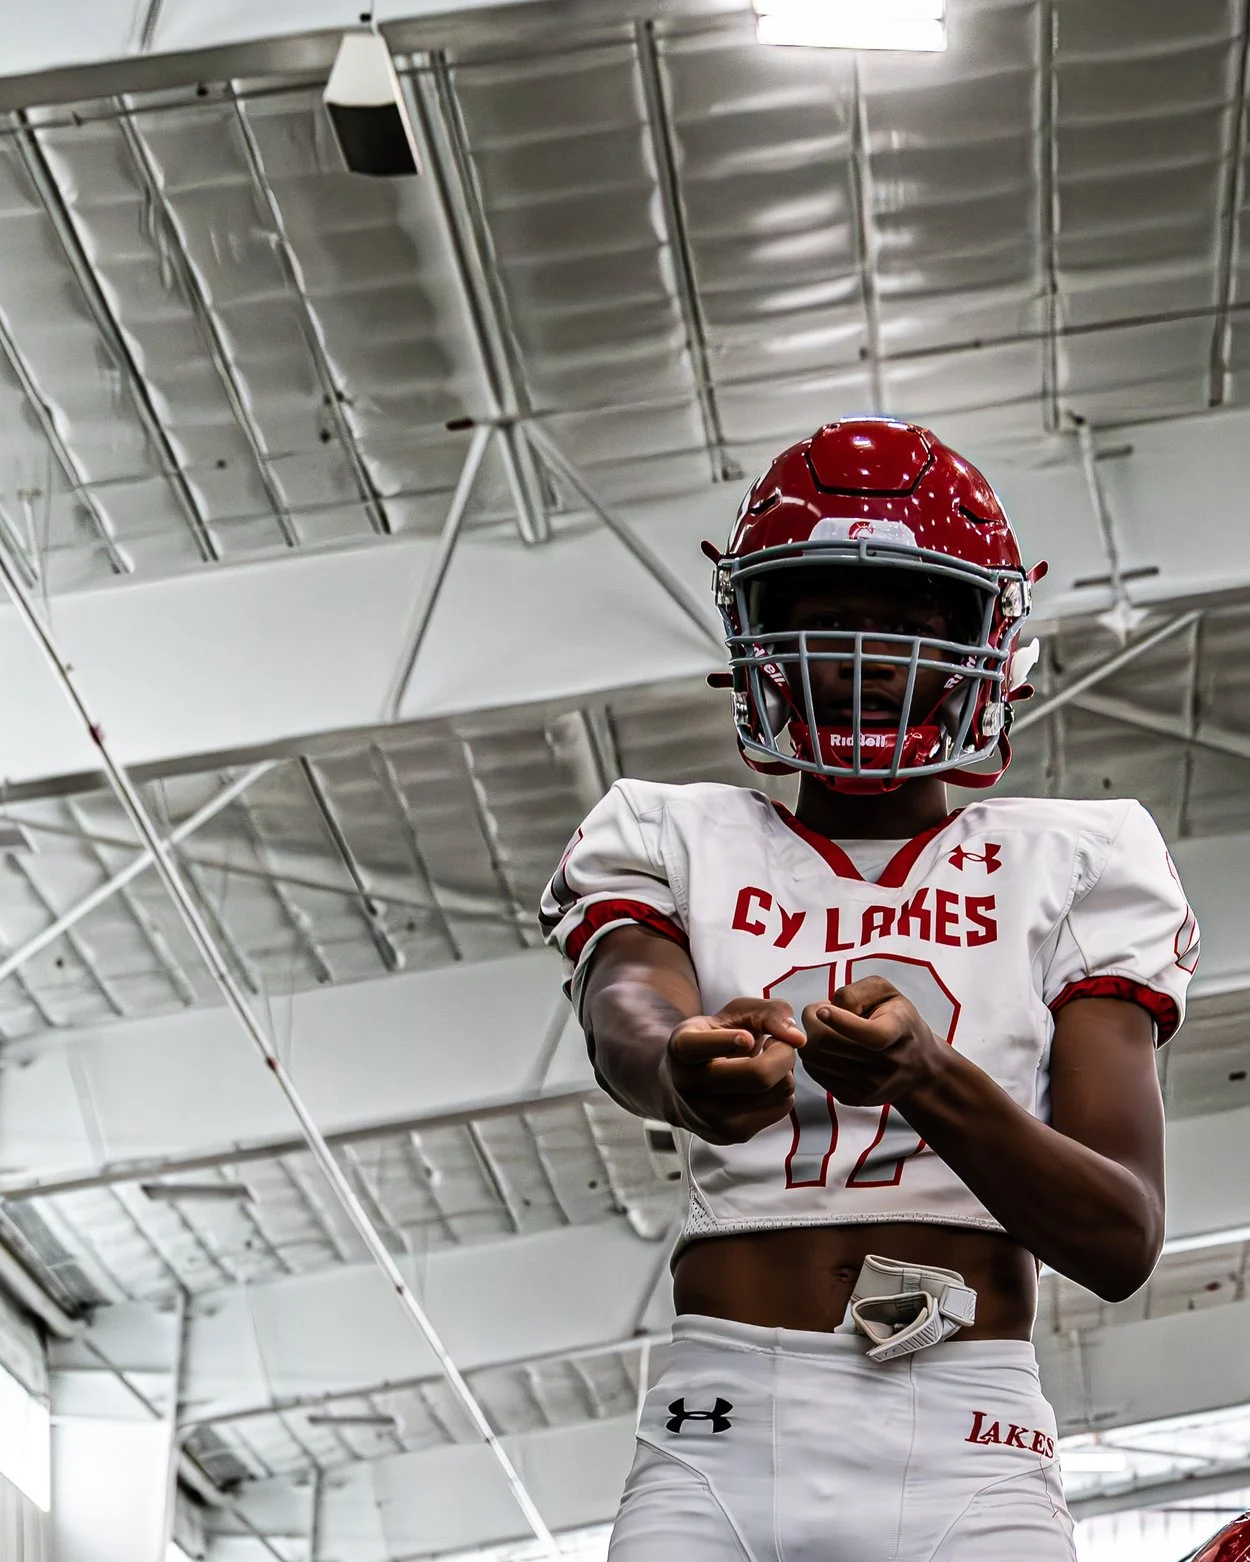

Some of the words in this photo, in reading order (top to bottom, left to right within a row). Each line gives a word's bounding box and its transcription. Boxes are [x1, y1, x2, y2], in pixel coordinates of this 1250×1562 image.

[731, 886, 807, 949] CY
[824, 887, 998, 953] LAKES
[964, 1410, 1055, 1459] LAKES
